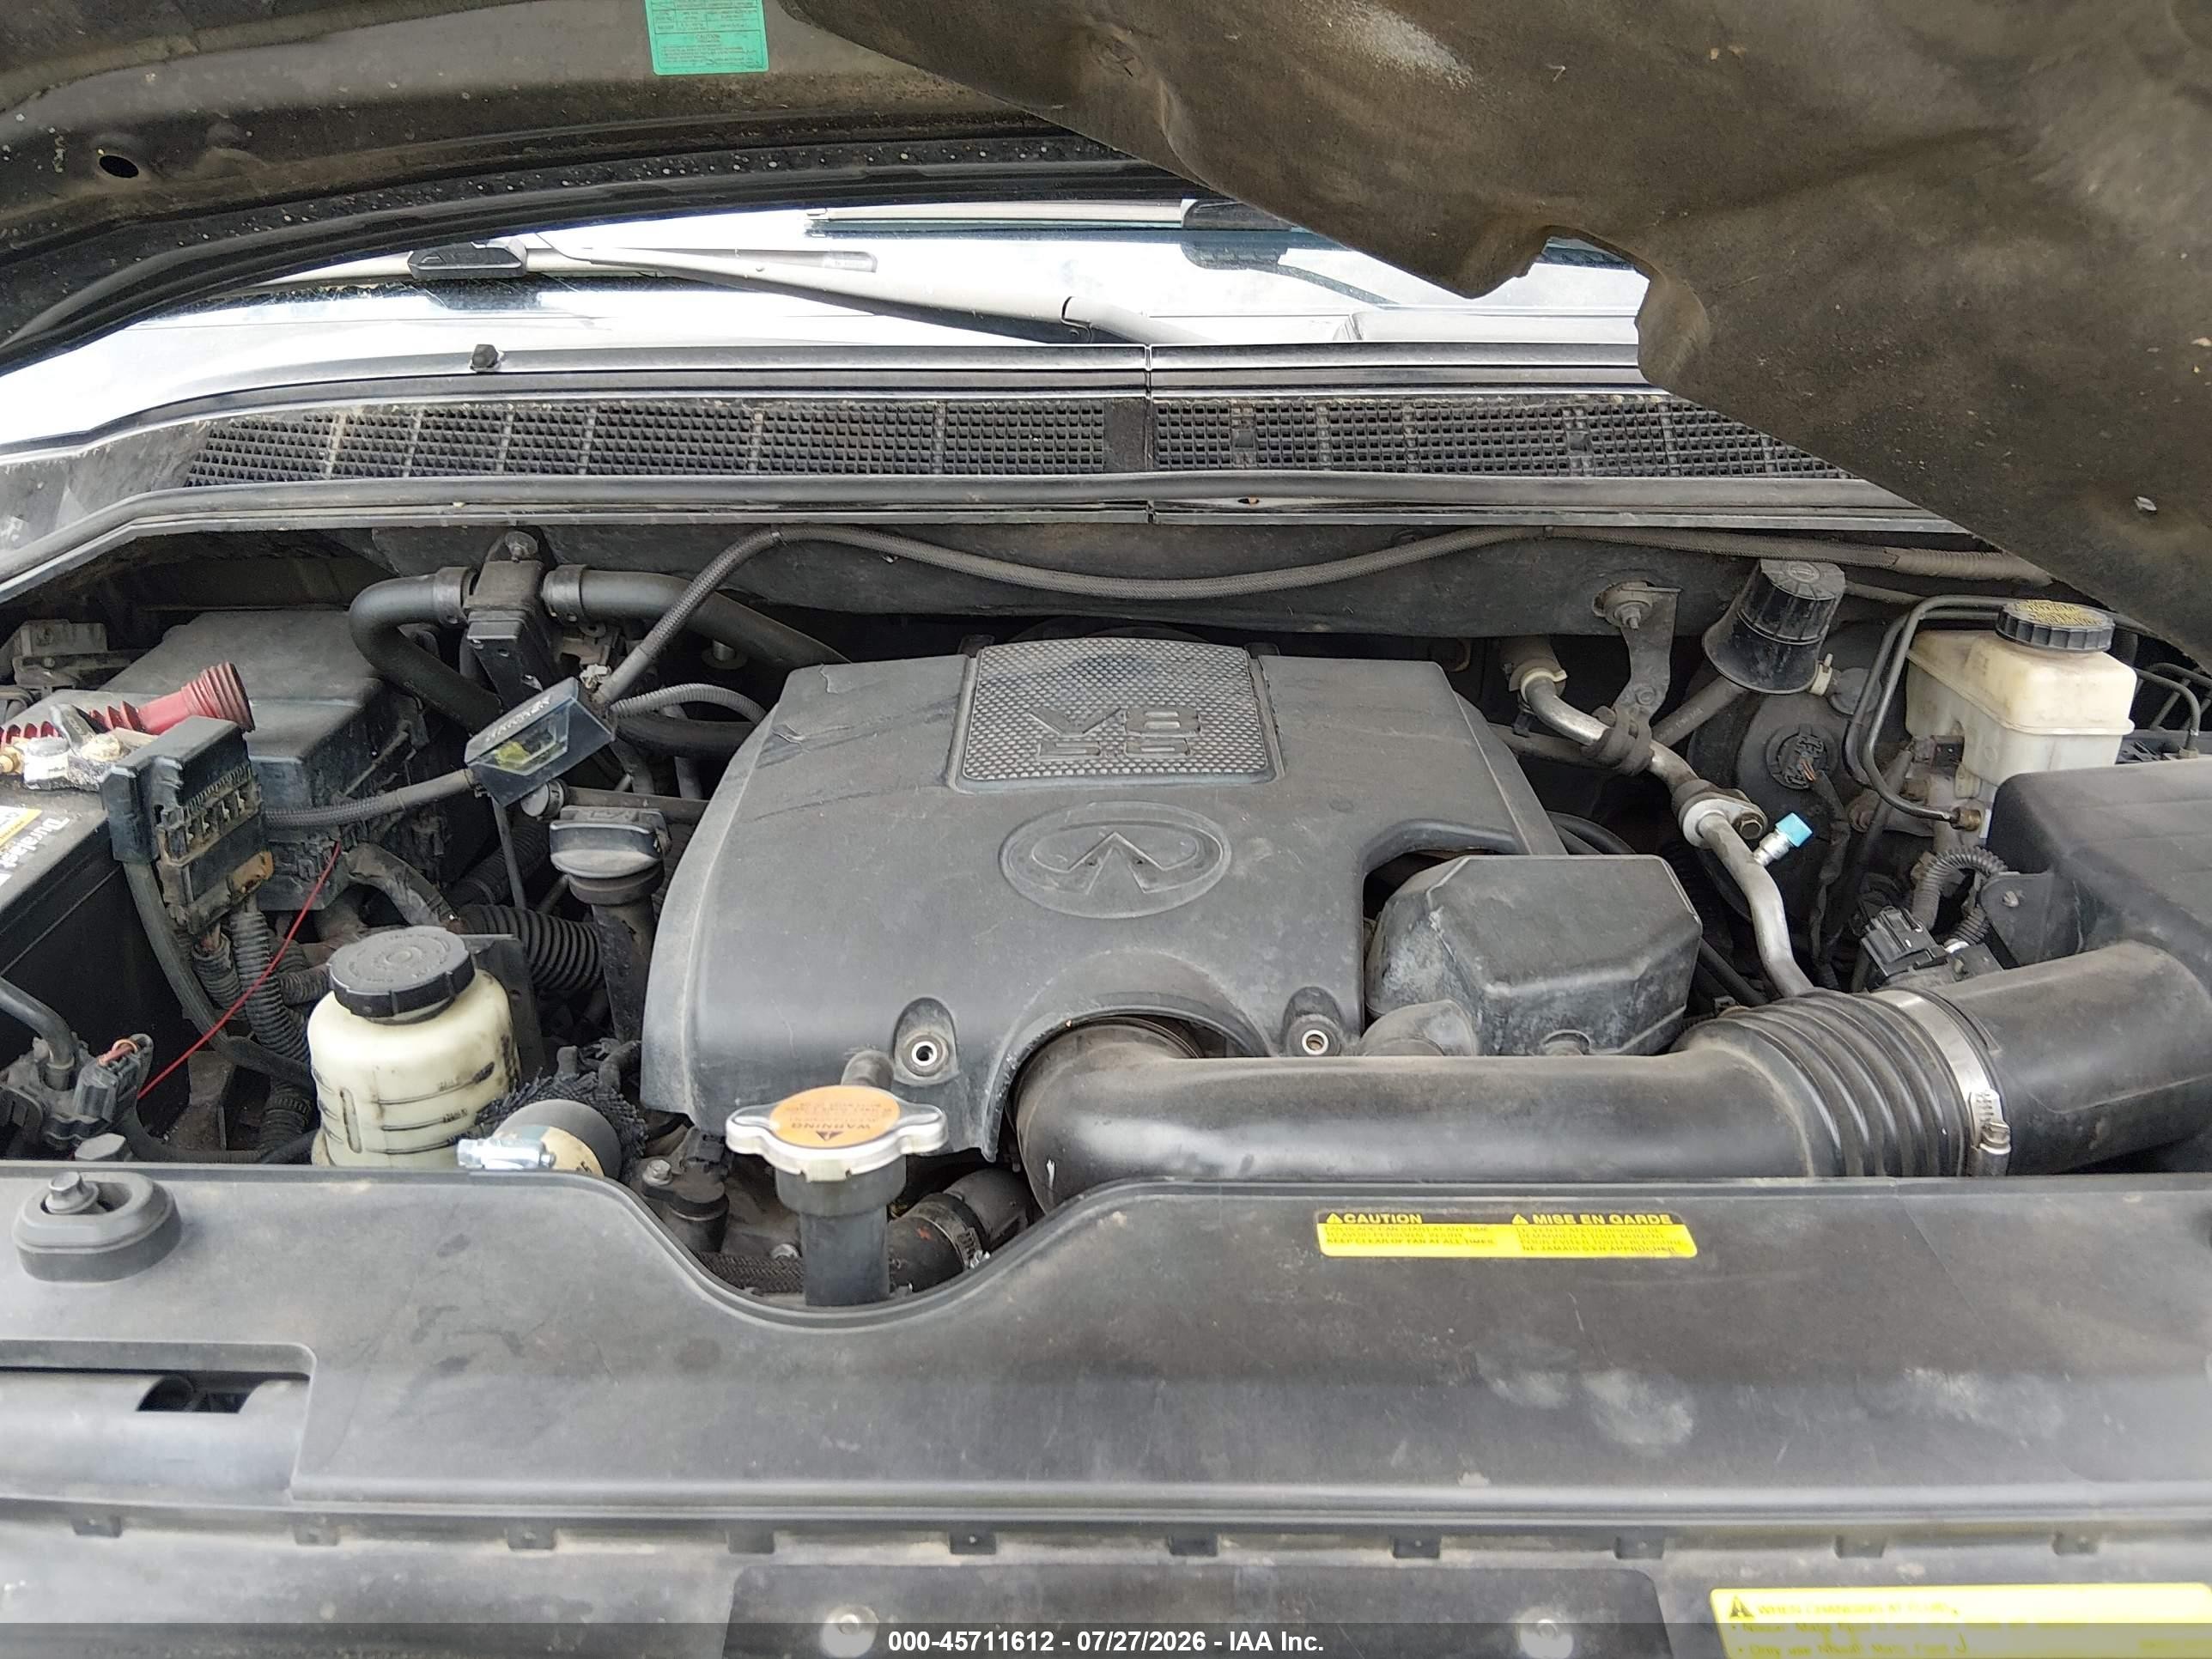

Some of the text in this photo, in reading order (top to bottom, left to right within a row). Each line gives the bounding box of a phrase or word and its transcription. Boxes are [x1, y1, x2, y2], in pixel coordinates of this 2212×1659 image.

[1030, 707, 1200, 737] V8
[790, 1121, 872, 1130] WARNING
[1343, 1213, 1423, 1224] CAUTION
[1532, 1213, 1674, 1224] MISE EN GARDE
